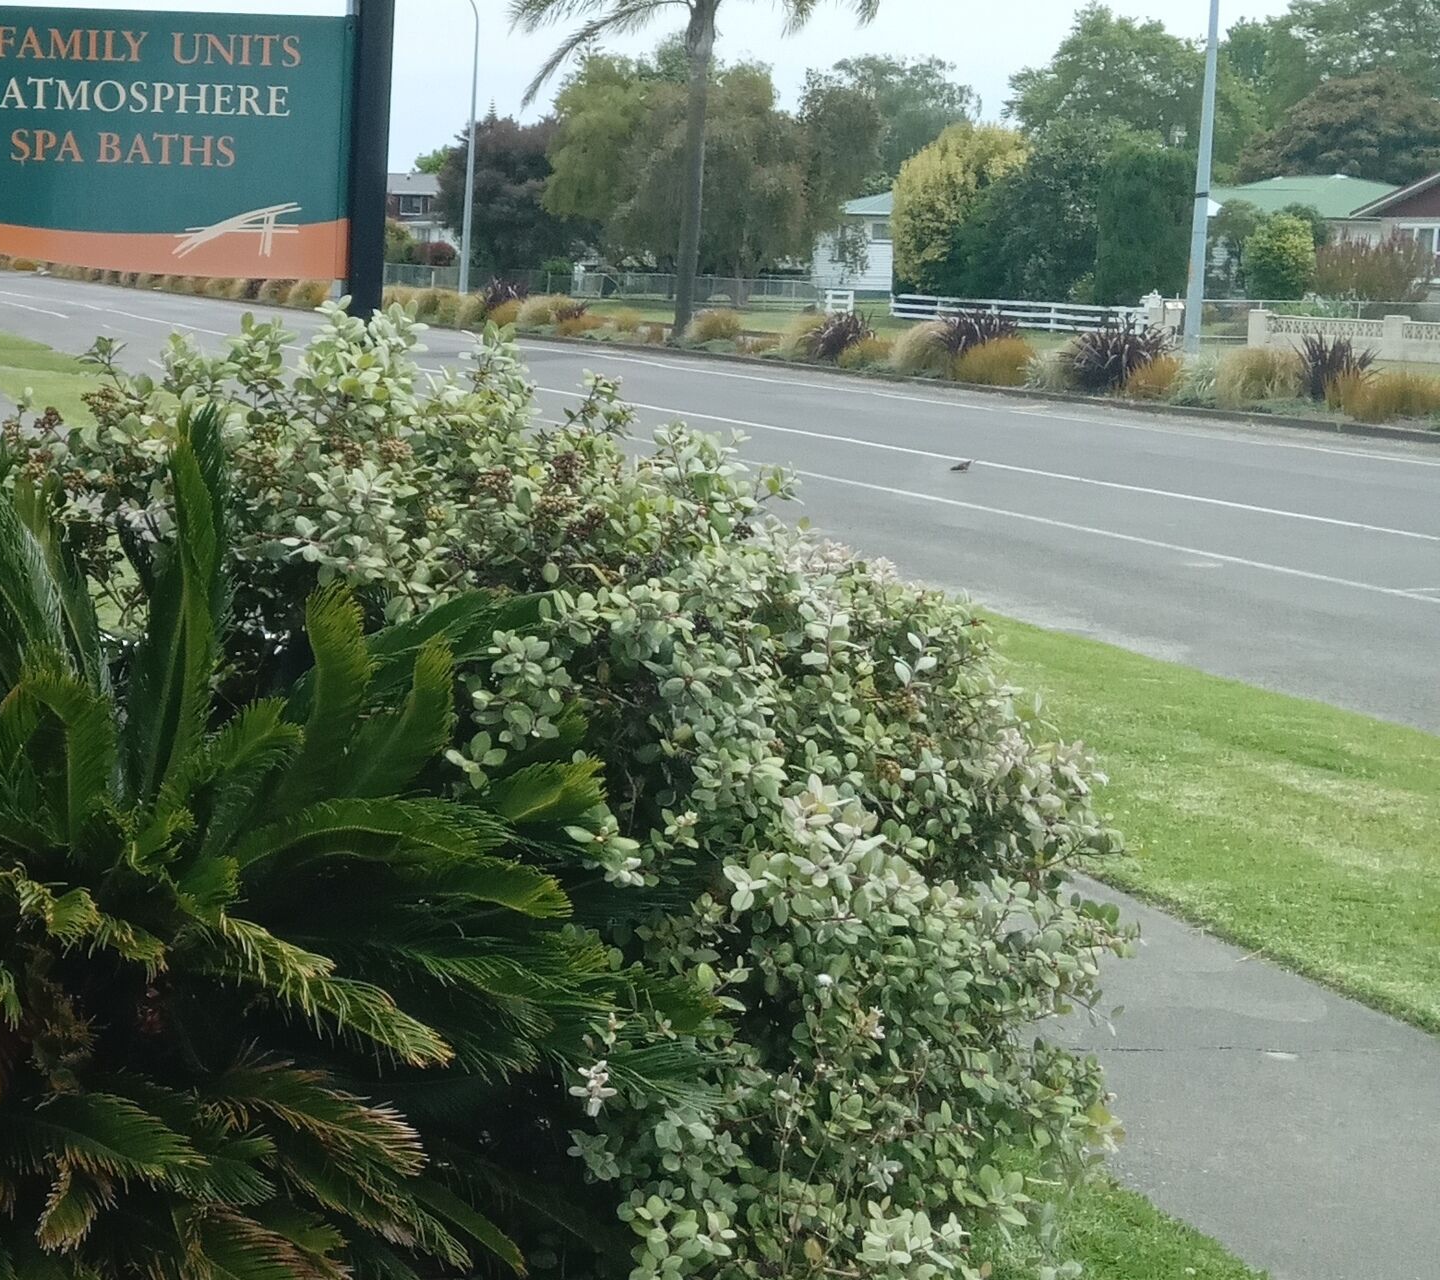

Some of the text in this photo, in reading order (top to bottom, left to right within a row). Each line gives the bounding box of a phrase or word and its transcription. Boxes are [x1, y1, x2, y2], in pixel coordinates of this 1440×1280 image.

[172, 33, 302, 67] UNITS
[10, 130, 82, 165] SPA
[98, 134, 236, 168] BATHS
